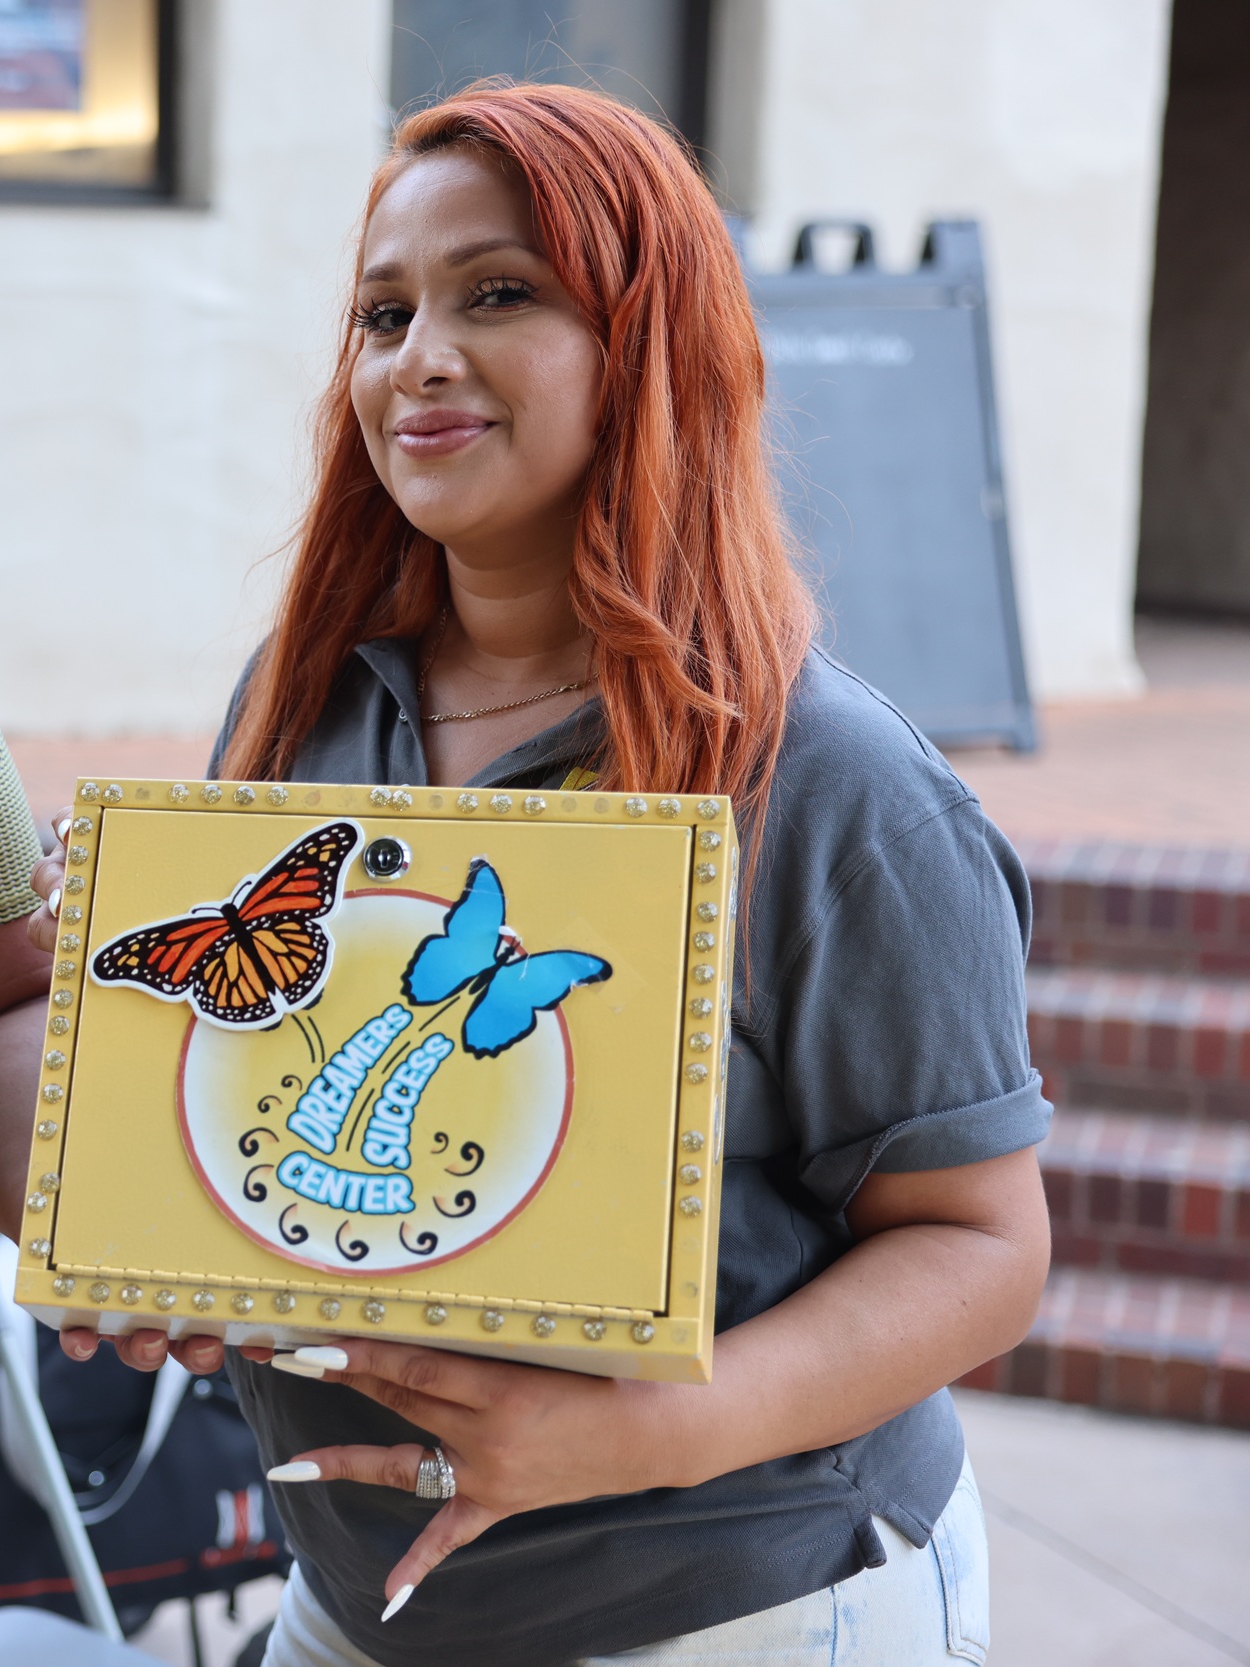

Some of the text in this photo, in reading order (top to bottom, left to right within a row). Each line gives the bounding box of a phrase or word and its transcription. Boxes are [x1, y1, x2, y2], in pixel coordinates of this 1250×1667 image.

[286, 1003, 413, 1155] DREAMERS
[361, 1032, 455, 1170] SUCCESS
[276, 1150, 416, 1215] CENTER
